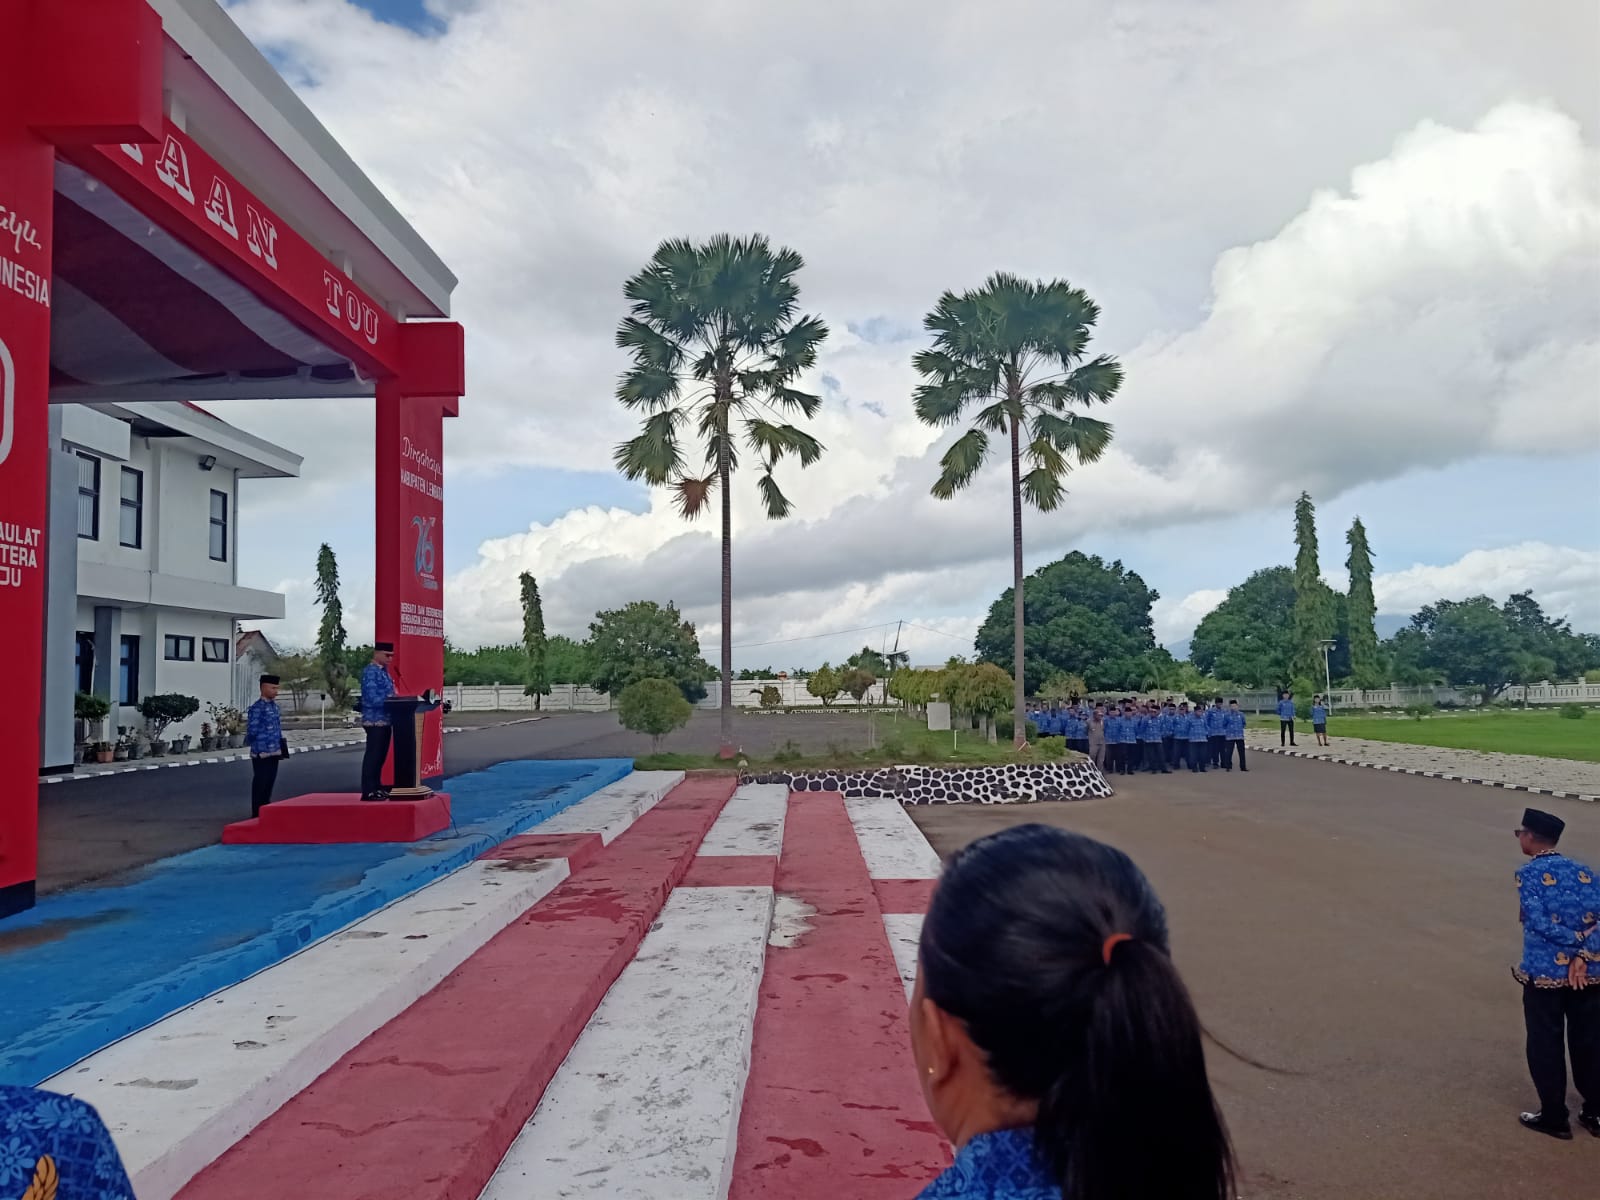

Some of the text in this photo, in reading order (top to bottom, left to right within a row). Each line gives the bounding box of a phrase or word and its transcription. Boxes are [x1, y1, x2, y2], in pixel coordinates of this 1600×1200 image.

[118, 133, 379, 345] AAN TOU
[0, 256, 50, 308] NESIA
[0, 544, 38, 568] TERA
